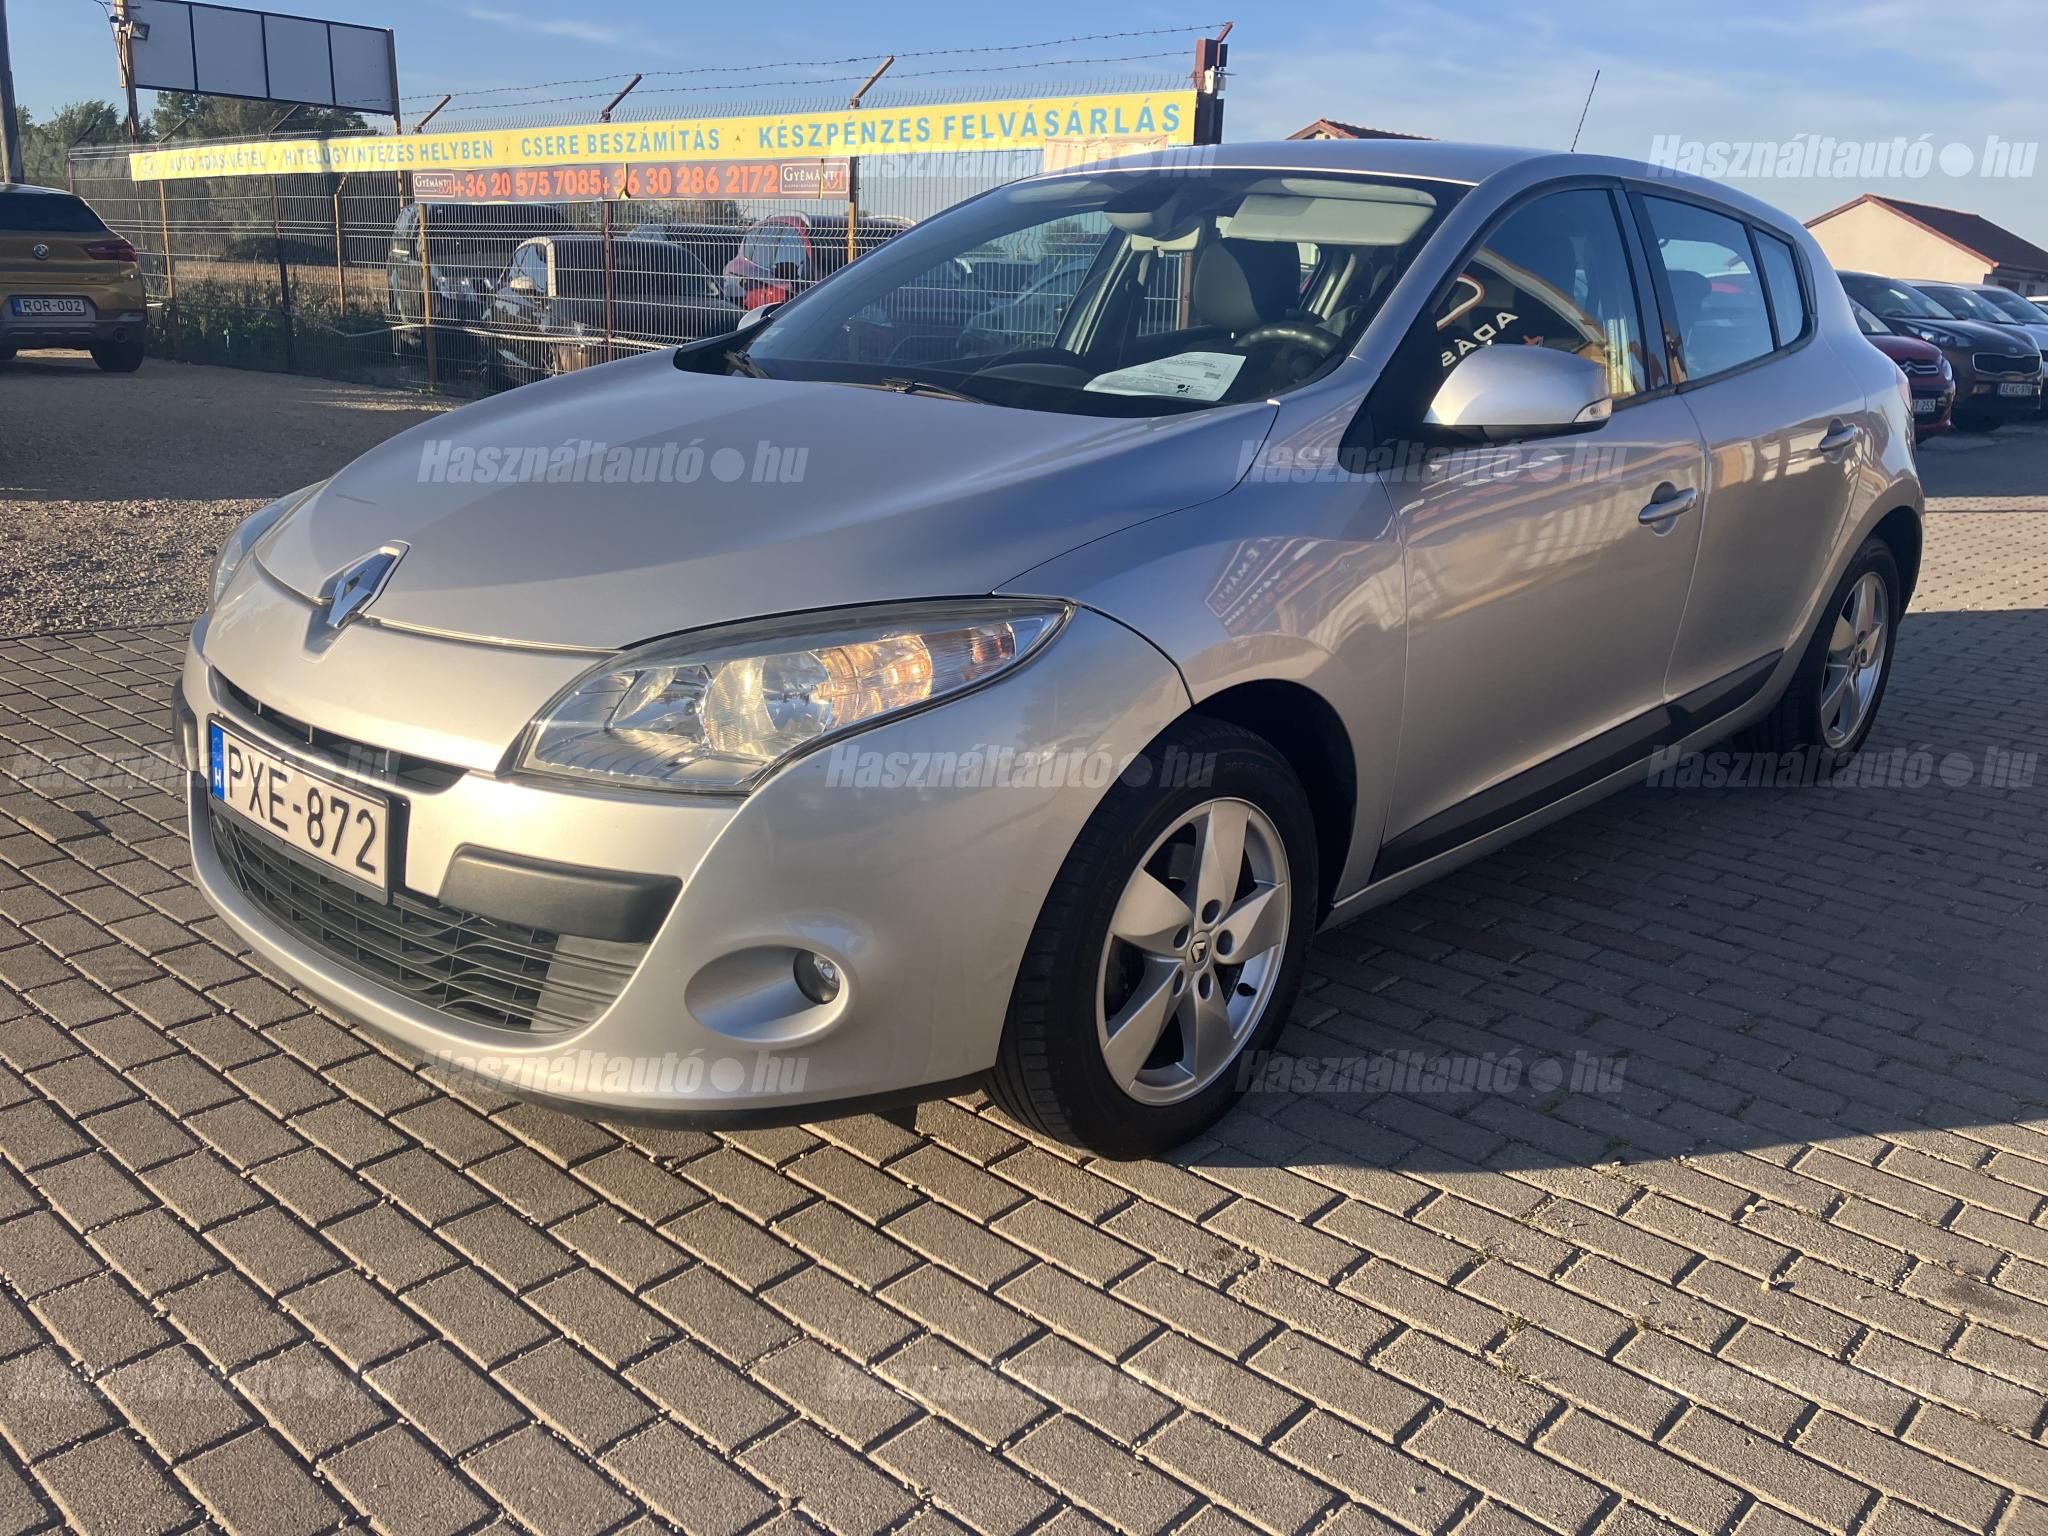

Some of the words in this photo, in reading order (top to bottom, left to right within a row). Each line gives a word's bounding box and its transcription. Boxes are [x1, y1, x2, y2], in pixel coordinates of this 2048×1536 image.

[758, 115, 931, 148] KÉSZPÉNZES
[944, 99, 1180, 140] FELVÁSÁRLÁS
[285, 141, 415, 165] HITELÜGYINTÉZÉS
[419, 139, 494, 161] HELYBEN
[521, 134, 580, 157] CSERE
[587, 124, 720, 153] BESZÁMÍTÁS
[455, 172, 486, 197] +36
[491, 171, 511, 196] 20
[516, 170, 549, 196] 575
[554, 168, 600, 195] 7085
[646, 166, 671, 194] 30
[676, 165, 719, 194] 286
[725, 164, 778, 193] 2172
[22, 300, 82, 312] ROR-002
[228, 743, 376, 875] PXE-872
